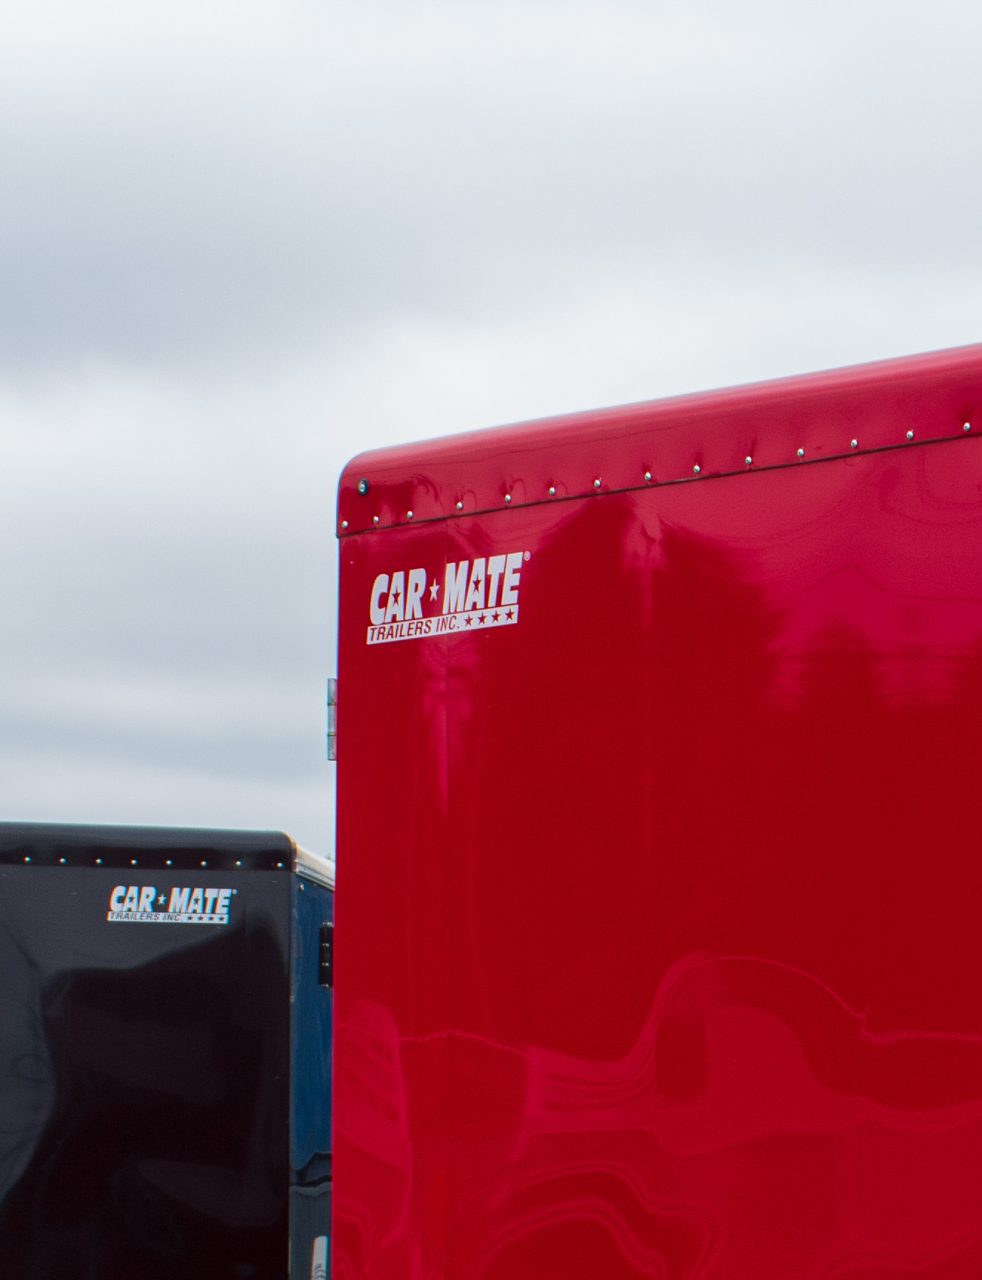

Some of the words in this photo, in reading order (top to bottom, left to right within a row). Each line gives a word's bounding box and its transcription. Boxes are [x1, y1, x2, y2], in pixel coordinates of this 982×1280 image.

[369, 568, 427, 625] CAR
[442, 552, 524, 614] MATE
[369, 619, 432, 642] TRAILERS
[436, 615, 460, 633] INC.
[109, 885, 157, 912] CAR
[168, 887, 233, 914] MATE
[110, 911, 160, 921] TRAILERS
